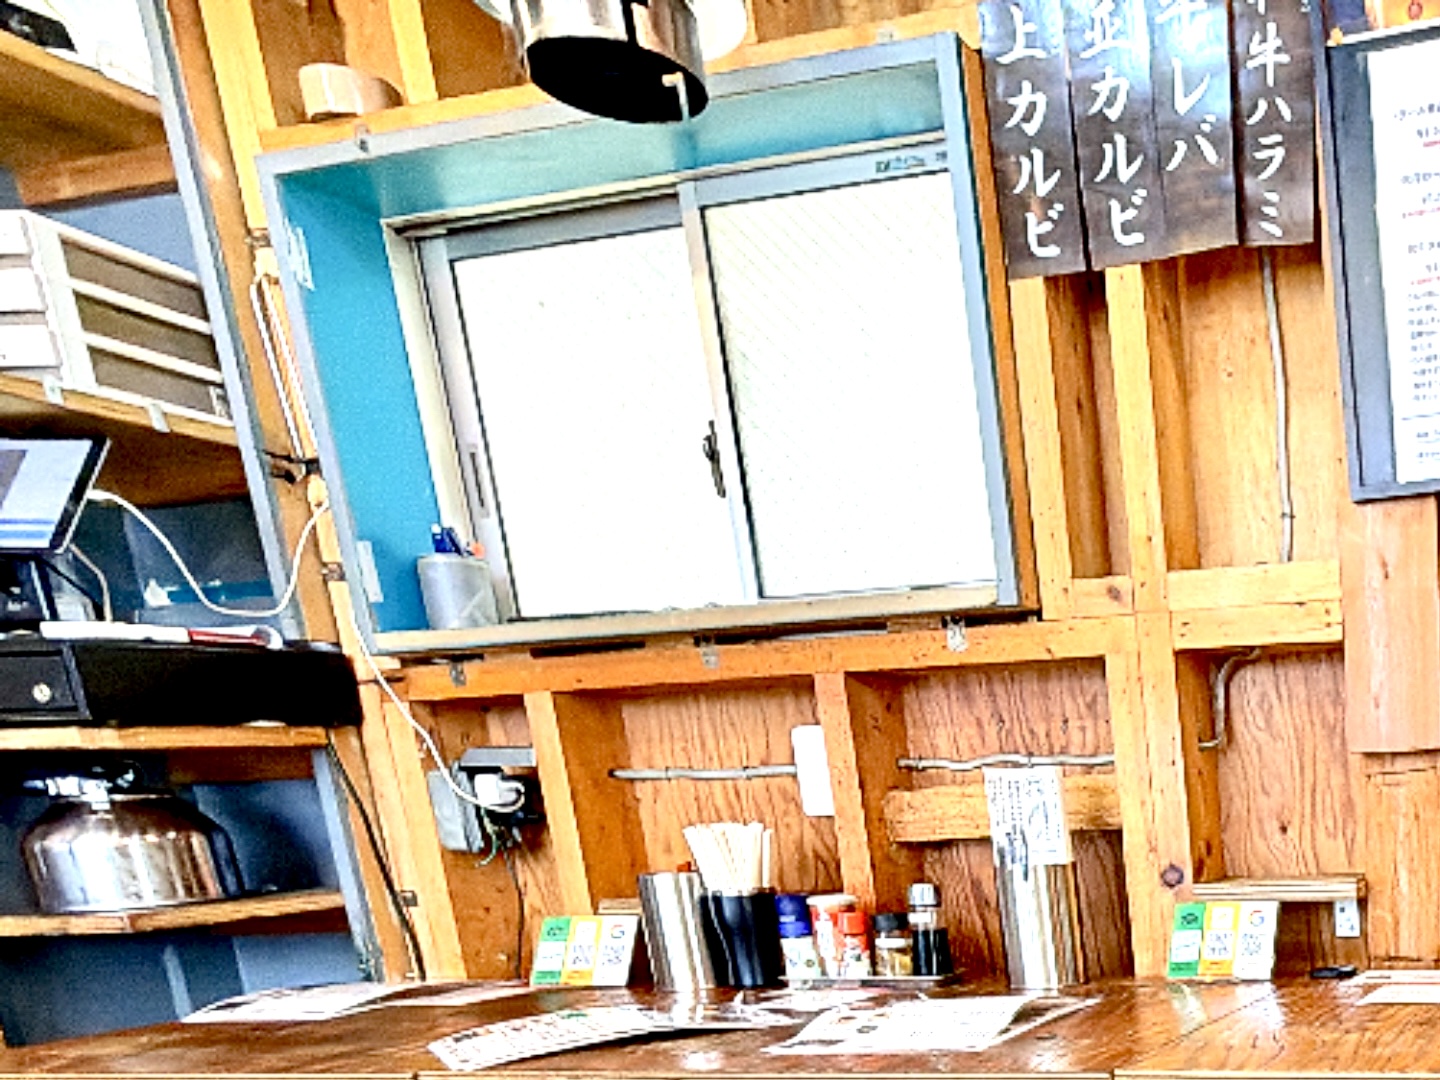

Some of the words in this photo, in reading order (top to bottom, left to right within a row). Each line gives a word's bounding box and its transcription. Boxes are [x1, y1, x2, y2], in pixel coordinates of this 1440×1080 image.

[996, 3, 1064, 258] 上カルビ
[1245, 0, 1306, 238] 牛ハラミ
